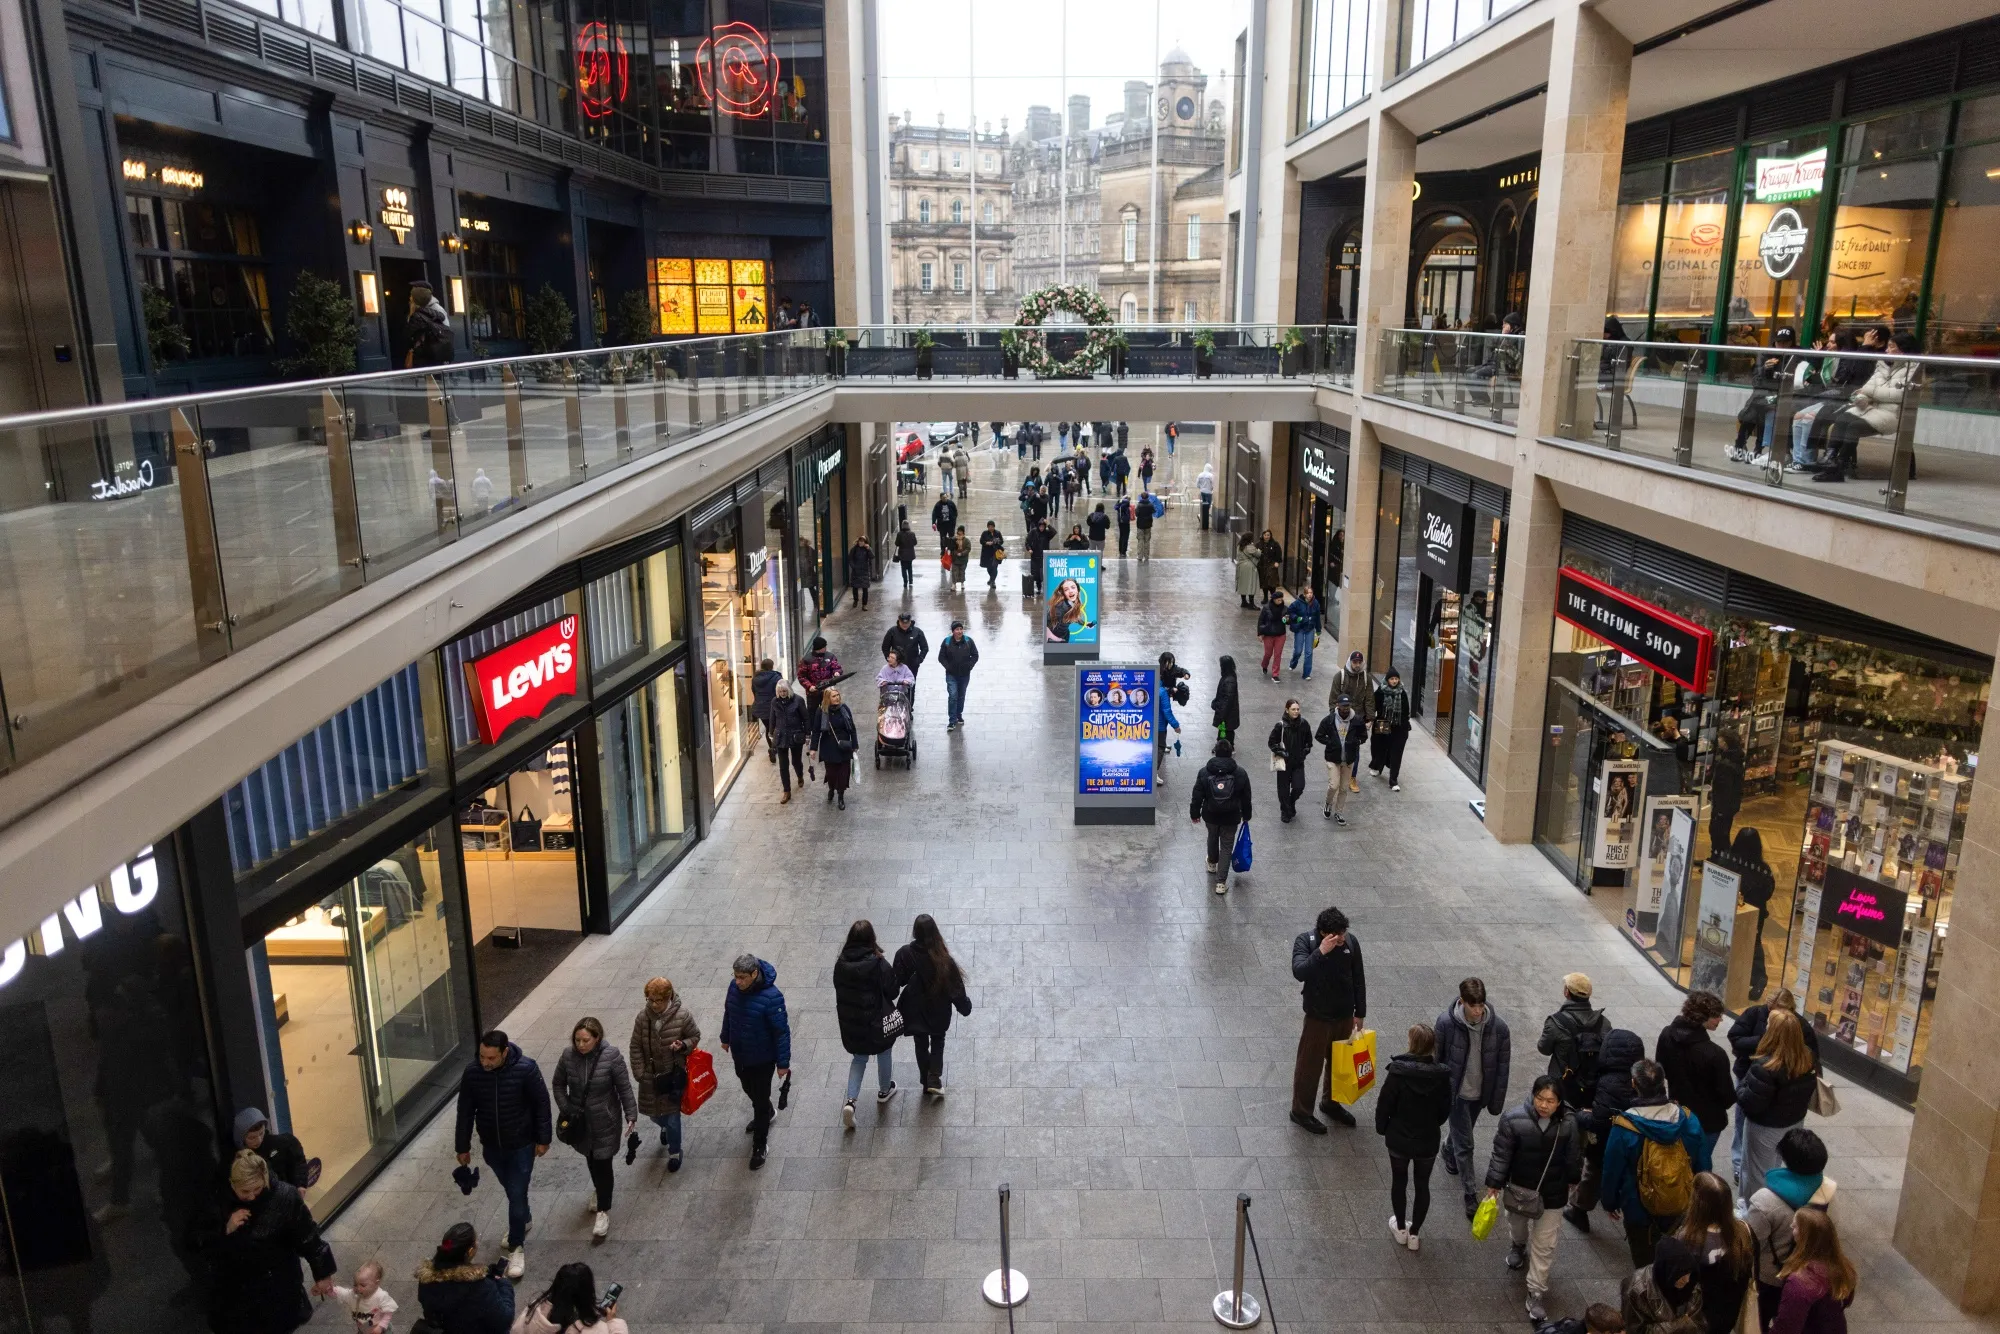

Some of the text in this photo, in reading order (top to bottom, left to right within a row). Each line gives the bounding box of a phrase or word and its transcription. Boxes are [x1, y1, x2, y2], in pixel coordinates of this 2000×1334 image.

[123, 159, 203, 188] BAR BRUNCH
[1759, 168, 1793, 189] Krispy
[1767, 190, 1812, 202] DOUGHNUTS
[1869, 243, 1891, 252] DAILY
[1642, 259, 1762, 270] OIGINAL GZED
[1837, 261, 1872, 270] SINCE 1937
[1777, 328, 1791, 336] NYC
[1423, 512, 1453, 548] Kiehl's
[750, 546, 767, 573] Dune
[1049, 558, 1068, 568] SHARE
[1054, 567, 1085, 577] DATA WITH
[1568, 592, 1682, 660] THE PERFUME SHOP
[1088, 713, 1143, 724] CHITTY CHITTY
[1083, 720, 1150, 740] BANG BANG
[1607, 845, 1623, 854] THIS
[1707, 866, 1735, 883] BURBERRY
[1849, 887, 1877, 905] Love
[0, 843, 159, 986] NG
[1838, 901, 1885, 919] perfume
[883, 1015, 904, 1034] QUARTE
